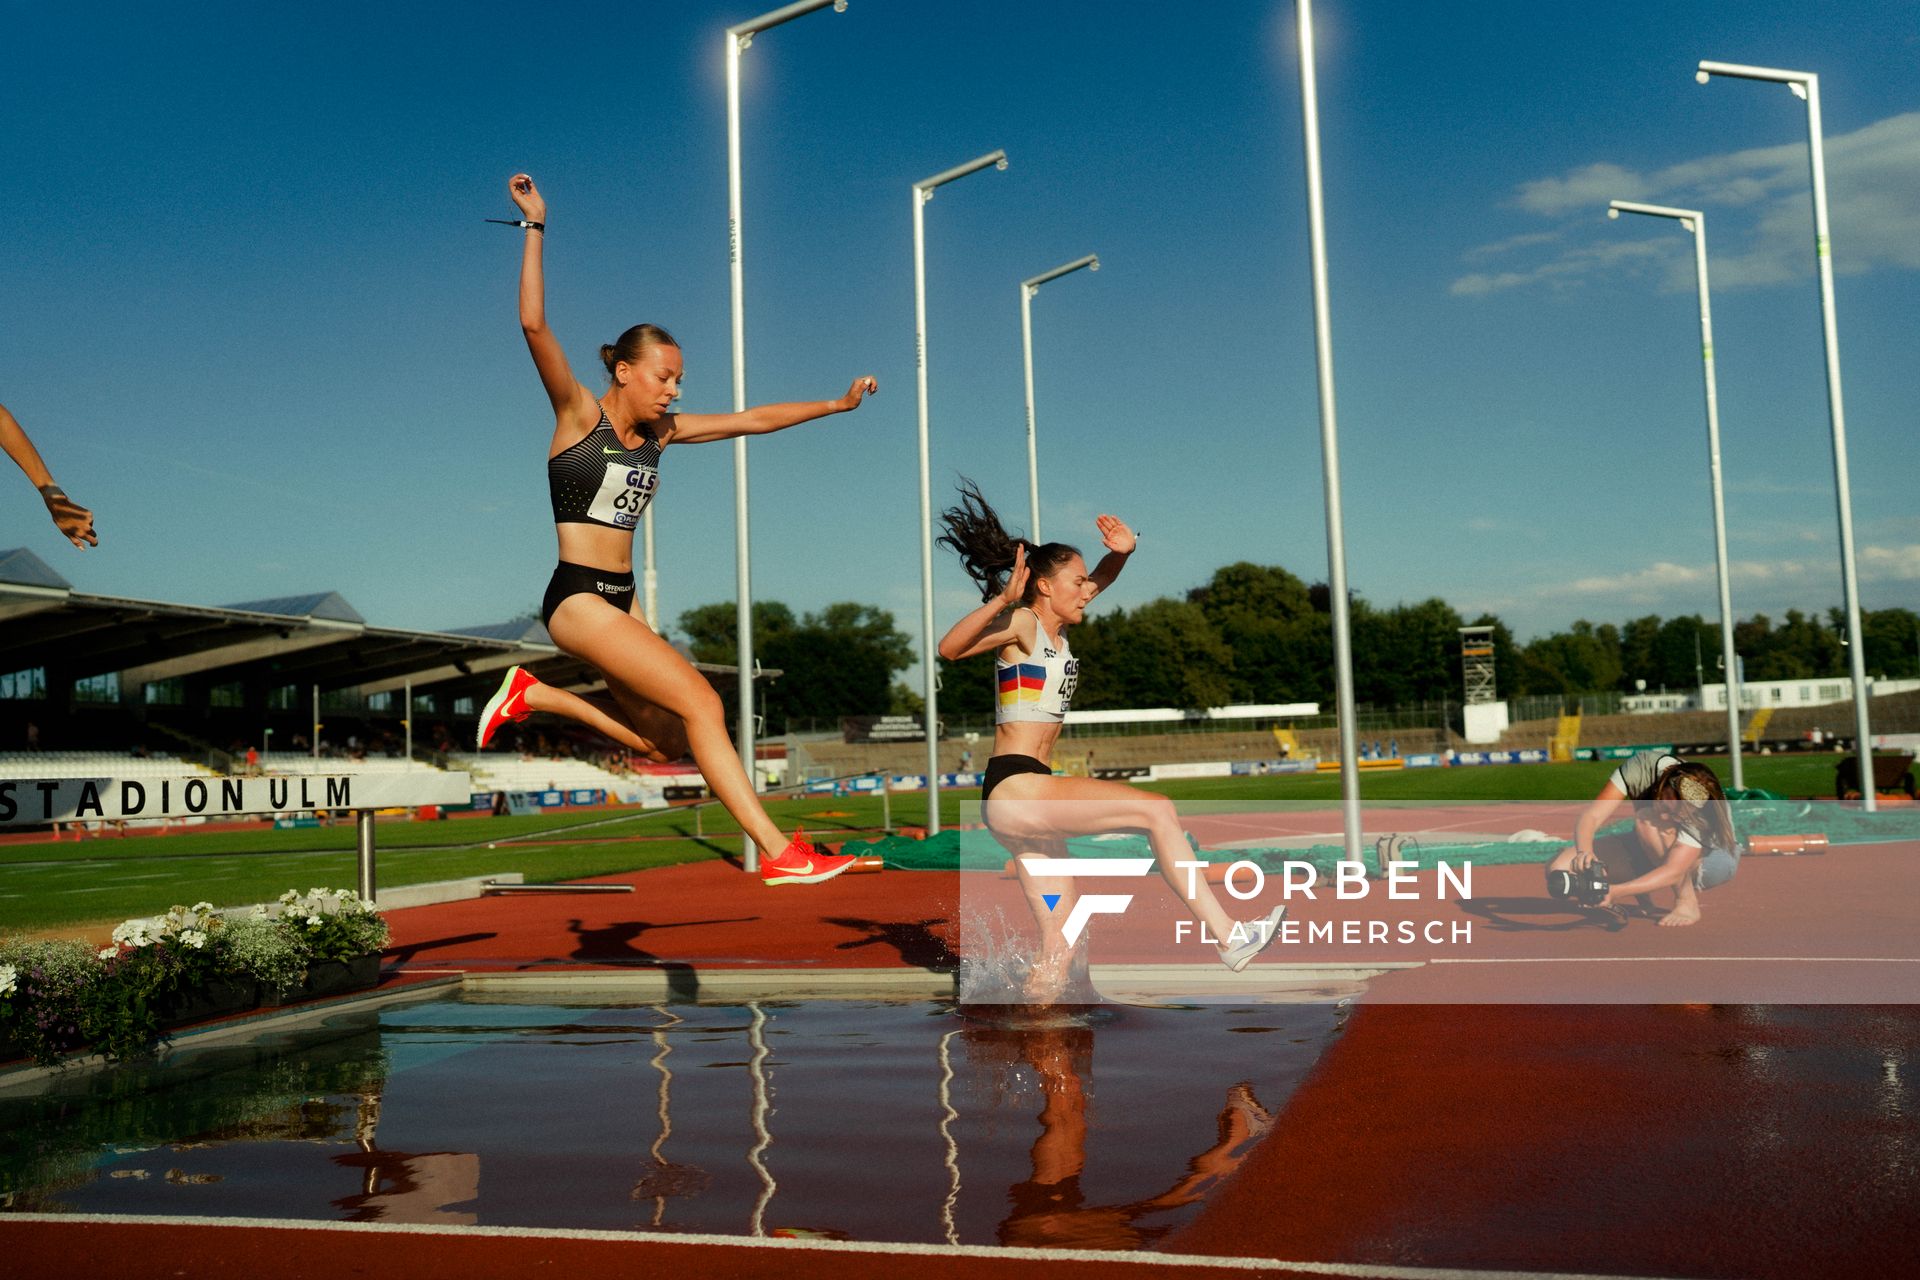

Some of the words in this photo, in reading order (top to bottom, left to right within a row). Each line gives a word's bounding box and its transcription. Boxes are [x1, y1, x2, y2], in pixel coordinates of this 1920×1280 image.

[626, 470, 657, 491] GLS
[613, 488, 652, 514] 637
[0, 778, 243, 822] STADION
[270, 776, 352, 810] ULM
